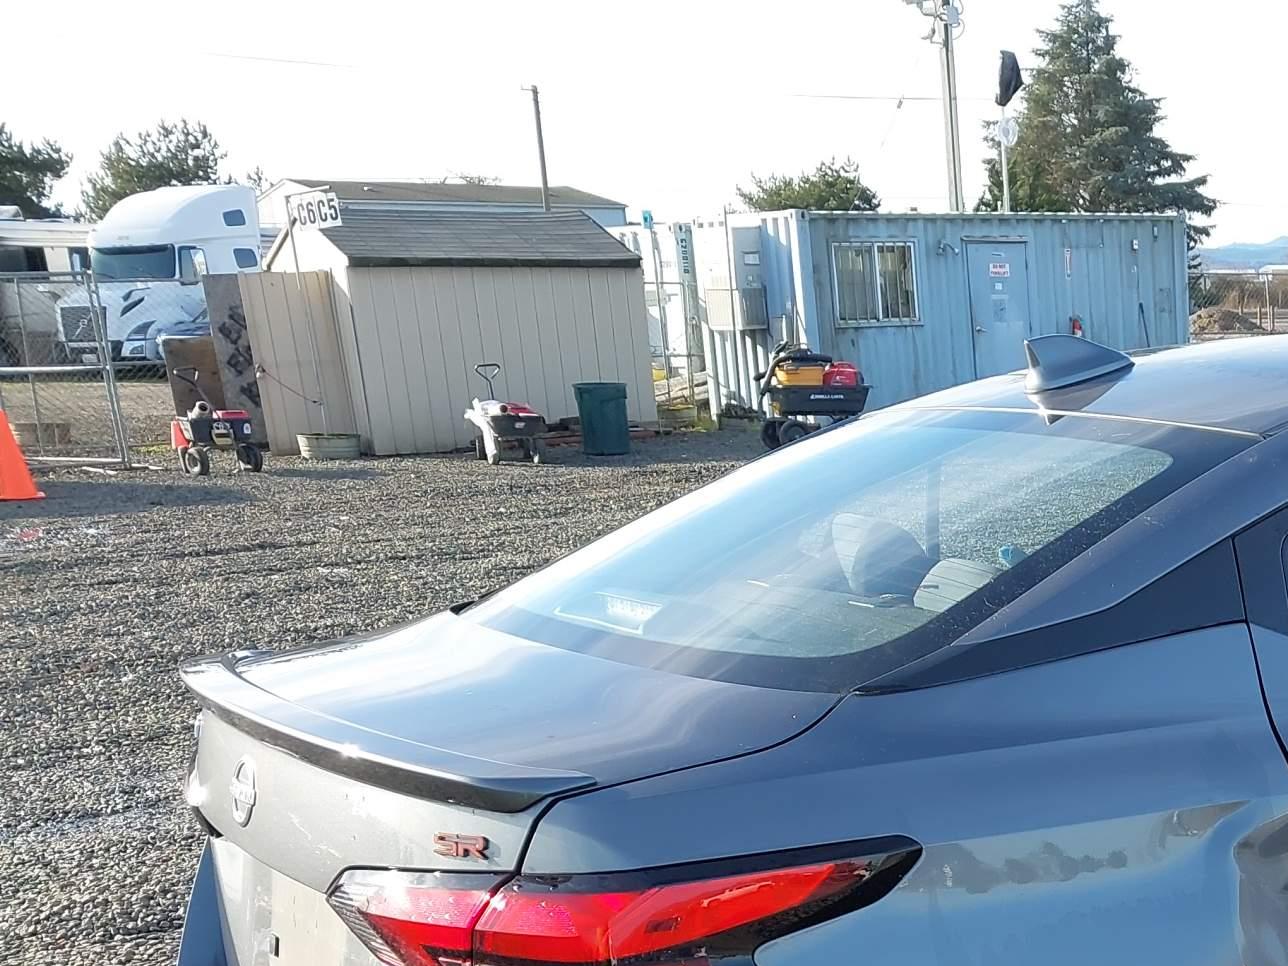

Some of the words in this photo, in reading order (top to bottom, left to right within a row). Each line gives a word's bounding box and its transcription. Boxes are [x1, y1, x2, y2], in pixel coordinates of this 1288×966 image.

[297, 202, 317, 226] C6
[317, 198, 339, 222] C5
[433, 832, 490, 861] SR
